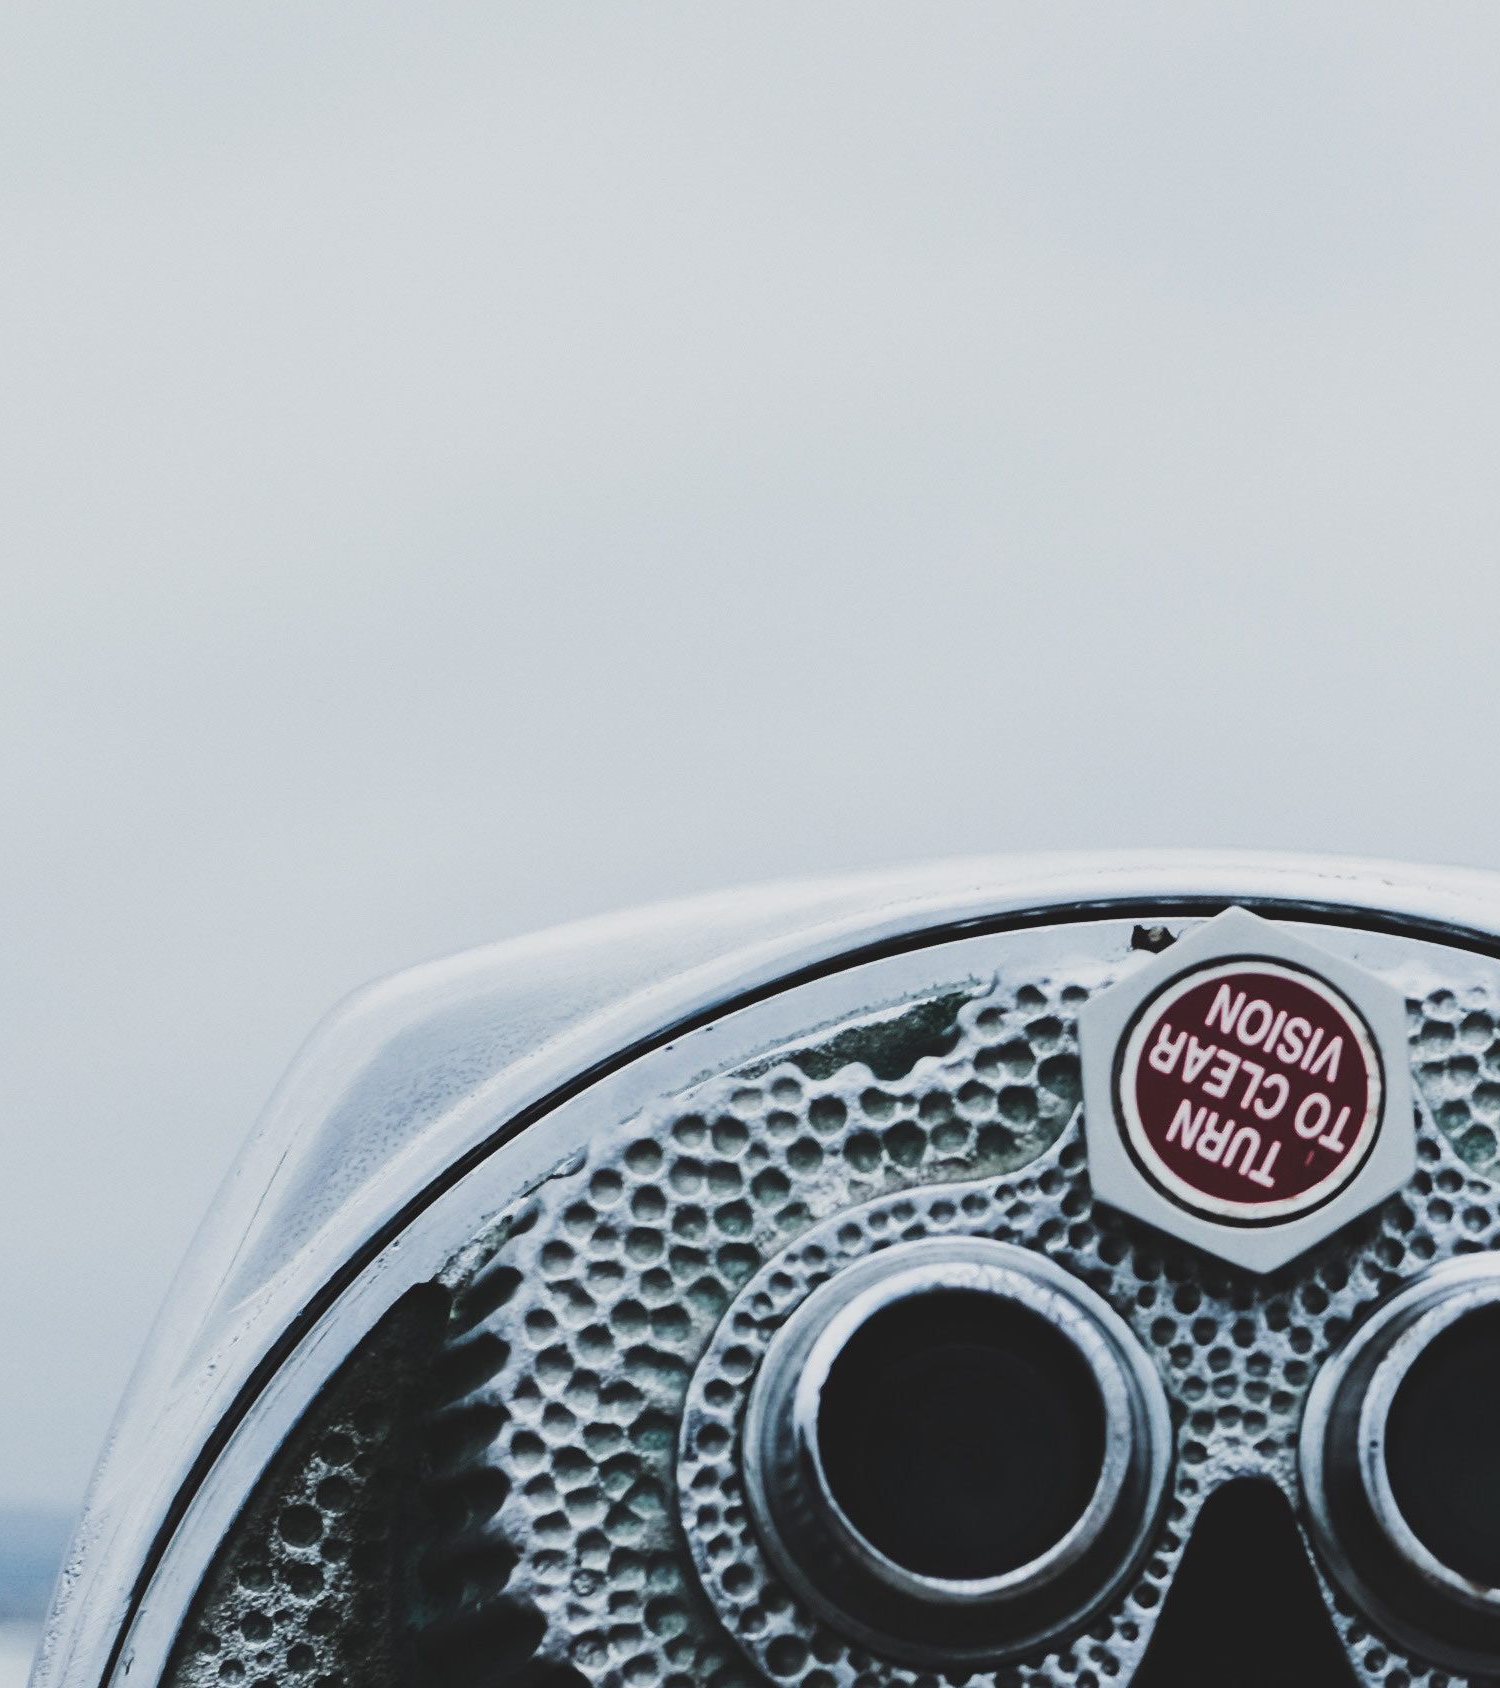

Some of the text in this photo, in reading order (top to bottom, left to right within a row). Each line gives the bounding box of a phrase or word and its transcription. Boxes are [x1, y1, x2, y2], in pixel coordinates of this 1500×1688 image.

[1204, 983, 1343, 1083] VISION
[1148, 1022, 1351, 1154] TO CLEAR
[1165, 1098, 1282, 1189] TURN
